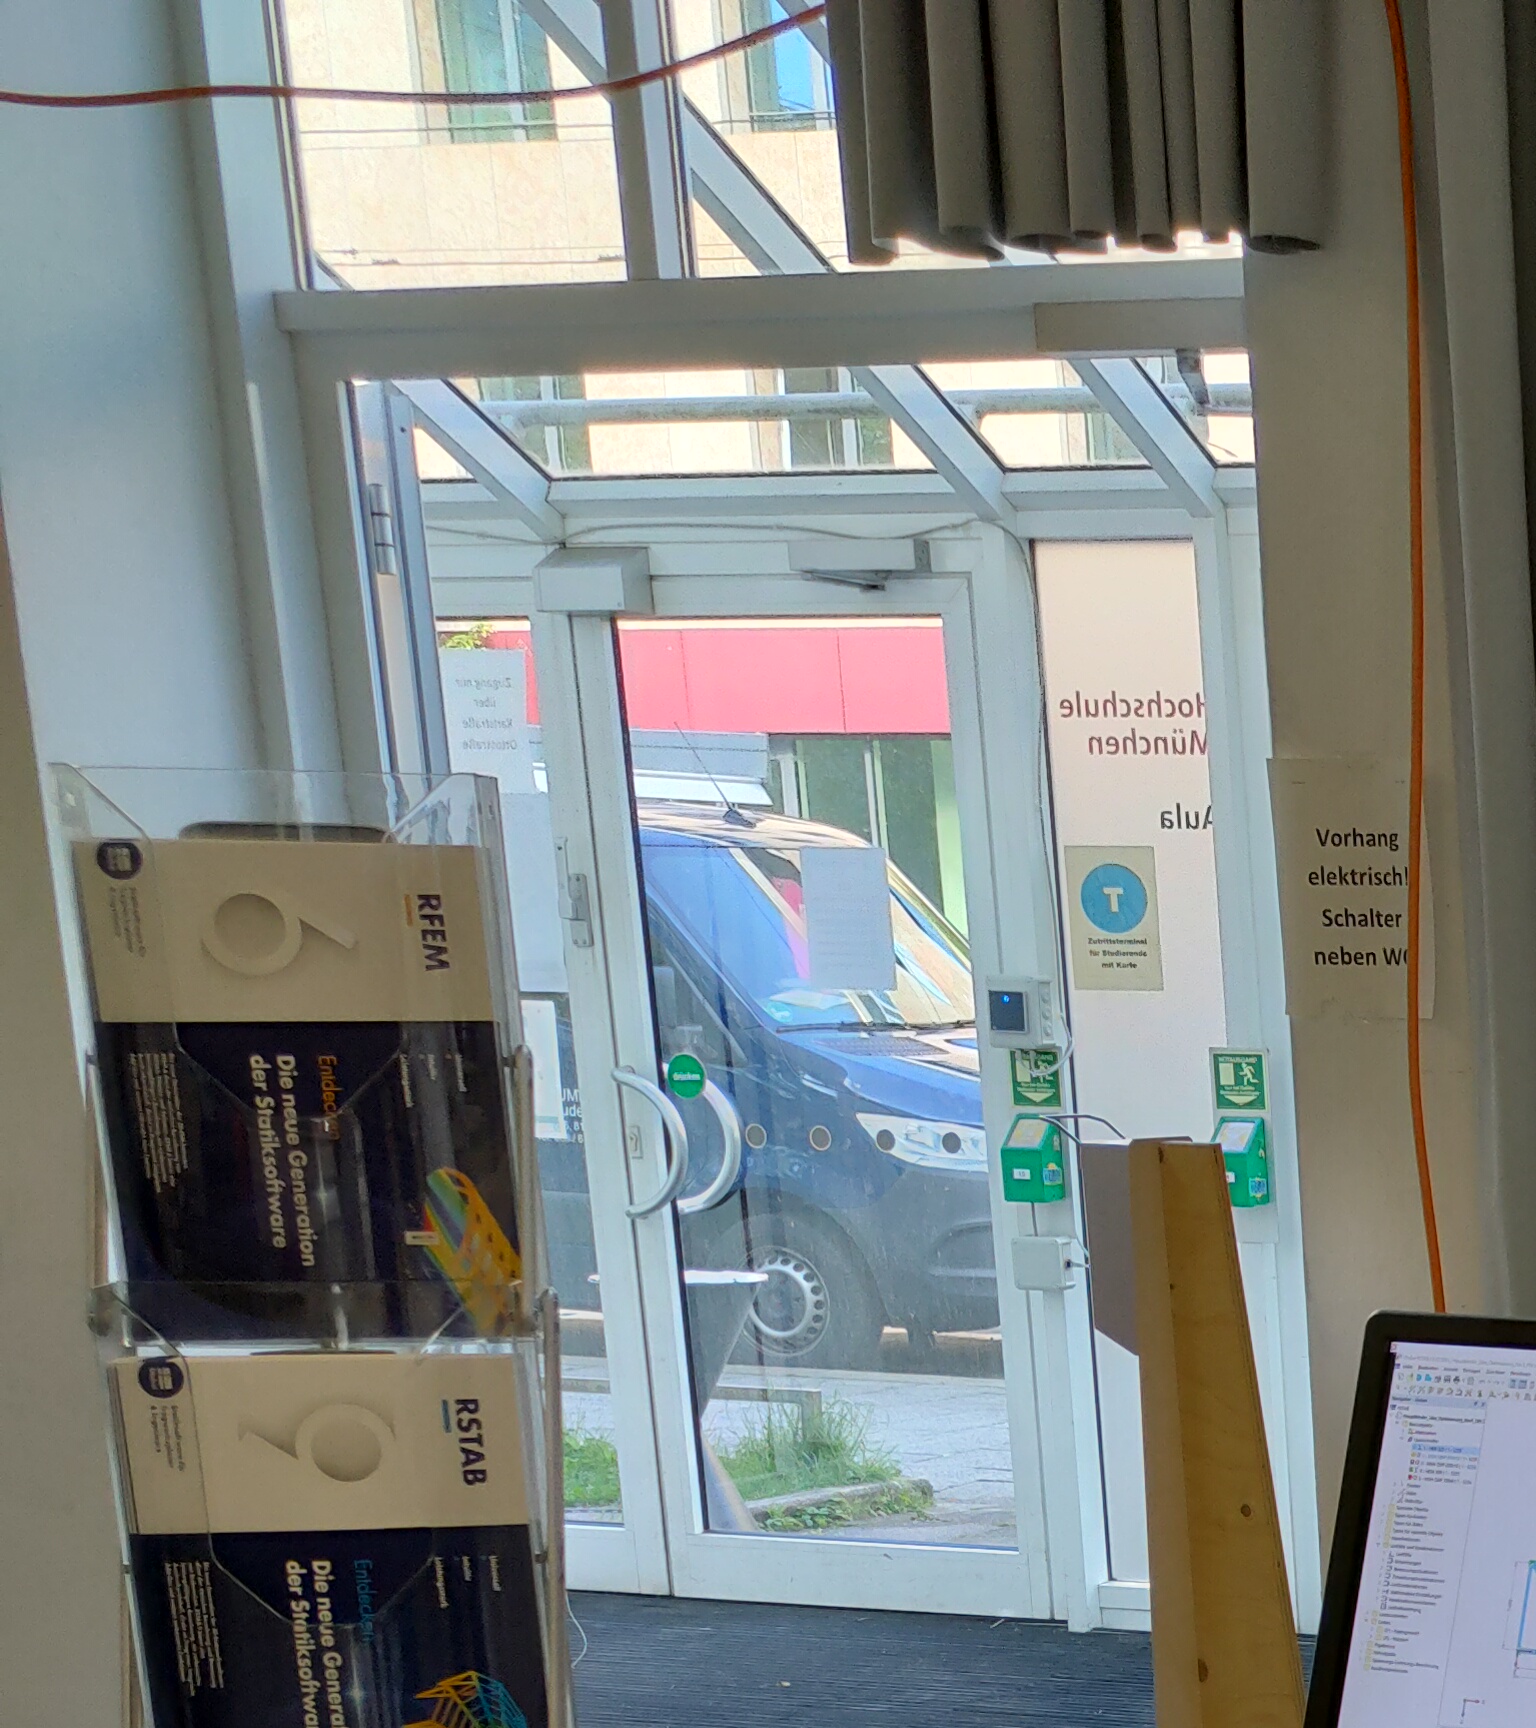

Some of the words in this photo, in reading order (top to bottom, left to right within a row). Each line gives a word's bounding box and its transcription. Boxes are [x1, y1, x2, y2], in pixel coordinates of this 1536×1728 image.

[1316, 828, 1398, 852] Vorhang
[417, 894, 450, 971] RFEM
[1322, 907, 1402, 927] Schalter
[1314, 946, 1377, 966] neben
[248, 1055, 270, 1090] der
[275, 1055, 297, 1089] Die
[280, 1095, 303, 1145] neue
[254, 1096, 288, 1248] Statiksoftware
[287, 1150, 318, 1266] Generation
[455, 1398, 487, 1486] RSTAB
[284, 1560, 305, 1594] der
[311, 1560, 333, 1593] Die
[315, 1598, 337, 1647] neue
